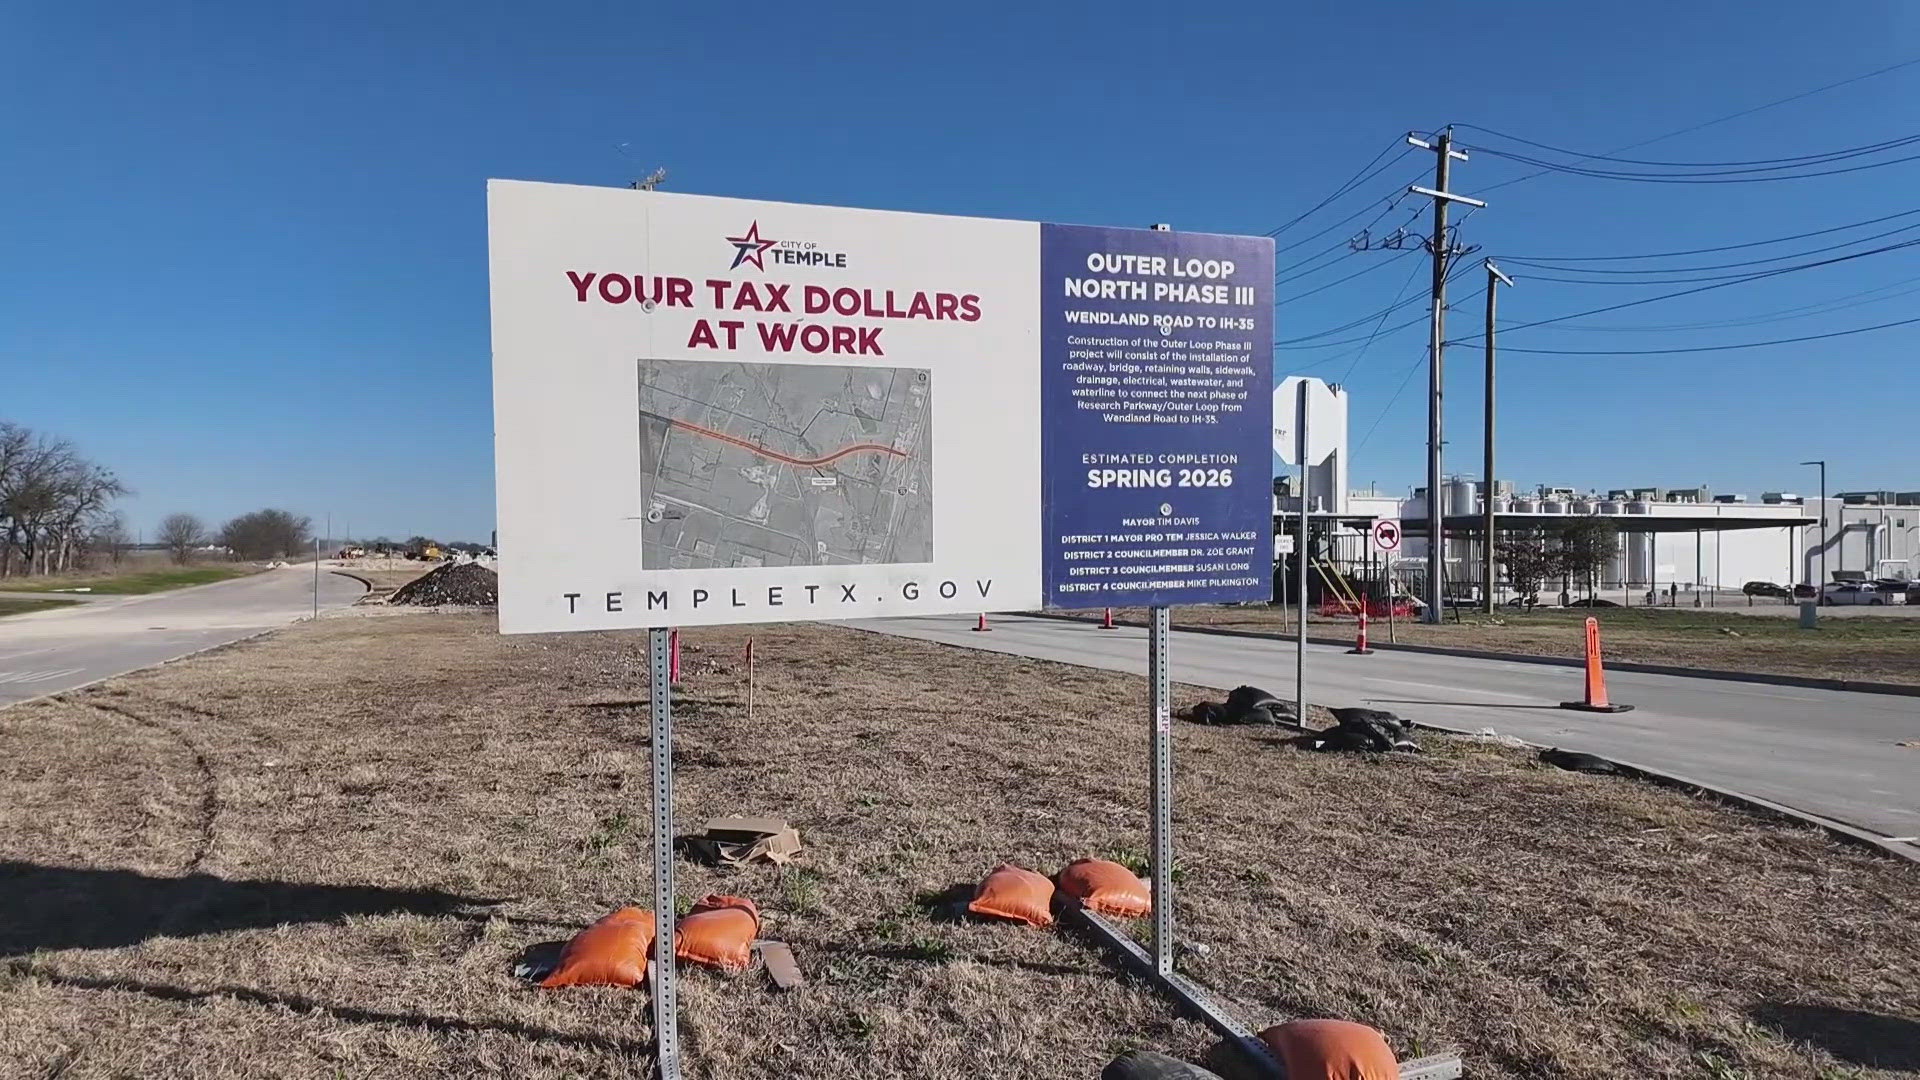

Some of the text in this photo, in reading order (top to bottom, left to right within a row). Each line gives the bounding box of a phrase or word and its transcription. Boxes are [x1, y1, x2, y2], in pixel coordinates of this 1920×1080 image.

[771, 249, 846, 268] TEMPLE
[1087, 253, 1235, 279] OUTER LOOP
[566, 271, 982, 322] YOUR TAX DOLLARS
[1065, 278, 1254, 305] NORTH PHASE III
[1065, 311, 1254, 330] WENDLAND ROAD TO IH-35
[687, 319, 884, 355] AT WORK
[1067, 335, 1128, 347] Construction
[1131, 338, 1141, 346] of
[1143, 338, 1158, 347] the
[1161, 339, 1187, 348] Outer
[1190, 340, 1213, 350] Loop
[1215, 341, 1241, 350] Phase
[1070, 349, 1250, 362] project will consist of the installation of
[1063, 362, 1255, 376] roadway, bridge, retaining walls, sidewalk,
[1076, 375, 1244, 388] drainage, electrical, wastewater, and
[1072, 388, 1115, 397] waterline
[1118, 389, 1128, 398] to
[1131, 390, 1167, 398] connect
[1170, 390, 1185, 398] the
[1210, 390, 1236, 400] phase
[1238, 391, 1247, 400] of
[1077, 400, 1242, 413] Research Parkway/Outer Loop from
[1103, 413, 1150, 422] Wendland
[1154, 414, 1177, 423] Road
[1180, 415, 1189, 423] to
[1082, 454, 1238, 464] ESTIMATED COMPLETION
[1088, 469, 1232, 488] SPRING 2026
[1123, 518, 1155, 526] MAYOR
[1062, 535, 1102, 543] DISTRICT
[1111, 534, 1143, 542] MAYOR
[1145, 534, 1163, 542] PRO
[1166, 533, 1183, 541] TEM
[1185, 533, 1219, 541] JESSICA
[1221, 532, 1257, 540] WALKER
[1064, 551, 1105, 559] DISTRICT
[1115, 549, 1188, 558] COUNCILMEMBER
[1207, 548, 1223, 556] ZOE
[1226, 547, 1254, 555] GRANT
[1070, 567, 1110, 576] DISTRICT
[1120, 565, 1194, 574] COUNCILMEMBER
[1196, 563, 1224, 572] SUSAN
[1226, 563, 1249, 571] LONG
[1060, 583, 1100, 592] DISTRICT
[1111, 580, 1185, 590] COUNCILMEMBER
[1187, 579, 1207, 587] MIKE
[1209, 578, 1258, 587] PILKINGTON
[564, 579, 991, 614] TEMPLETX.GOV
